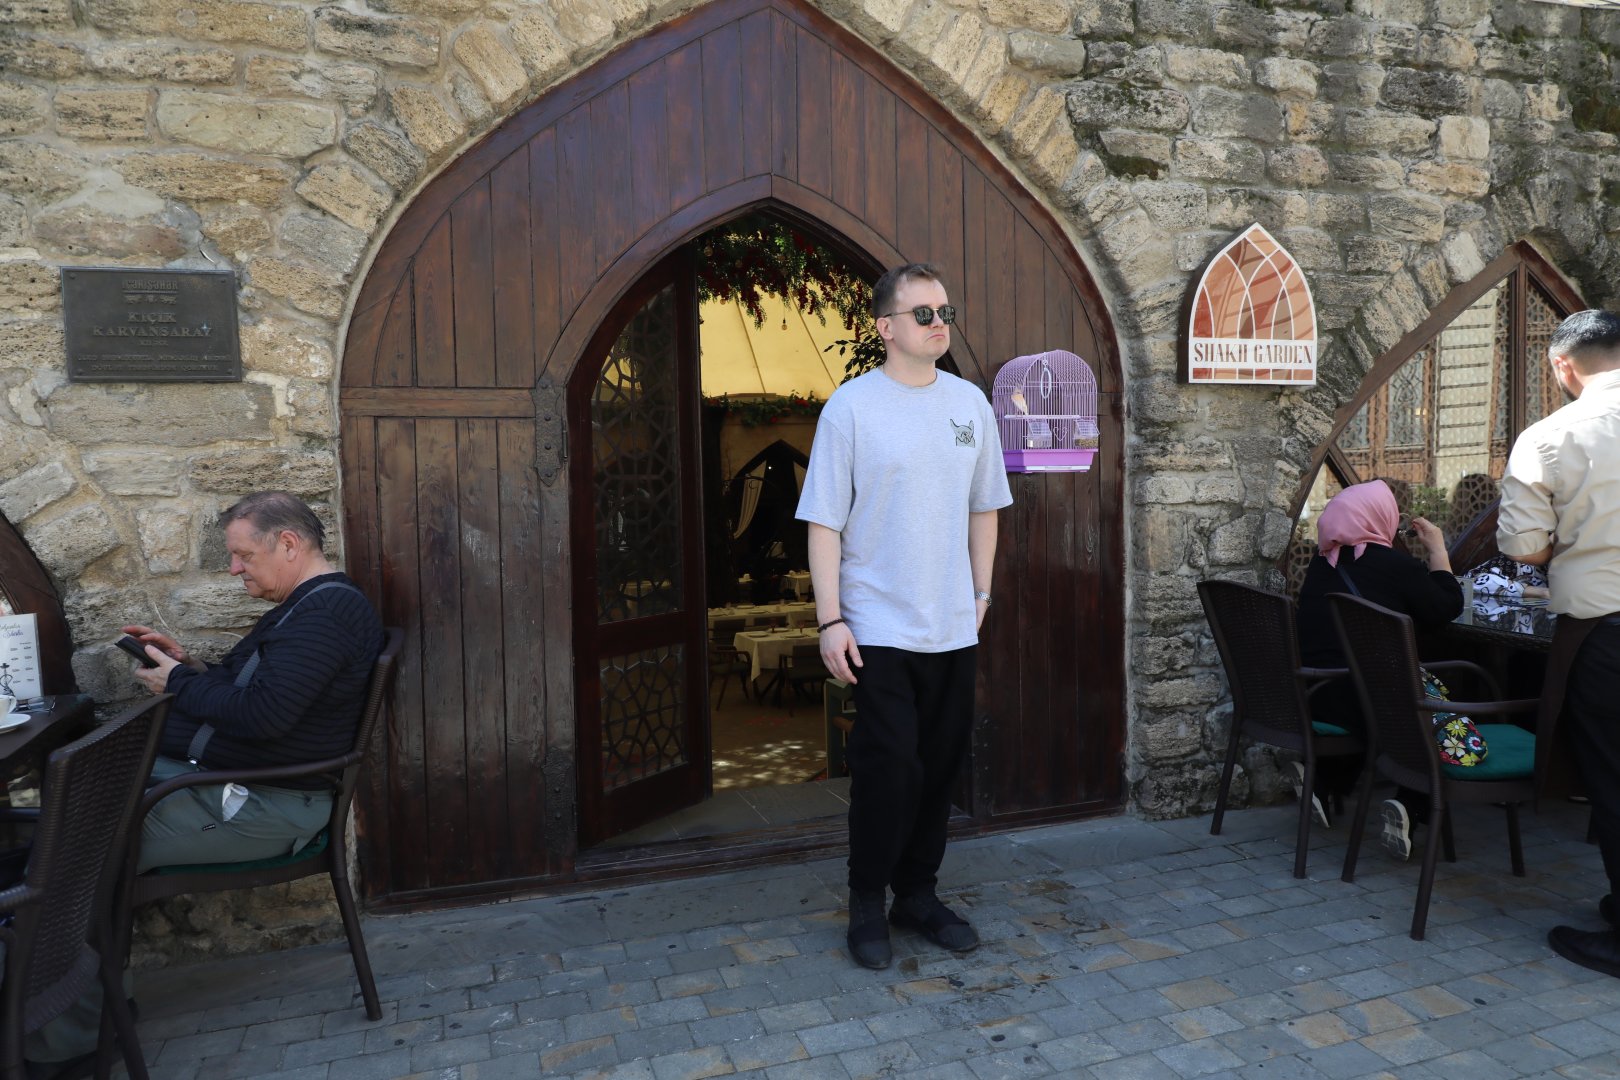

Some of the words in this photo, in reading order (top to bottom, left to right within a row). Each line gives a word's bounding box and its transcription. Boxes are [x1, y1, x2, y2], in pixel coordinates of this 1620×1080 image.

[92, 325, 212, 337] KARVANSARAY
[1193, 342, 1248, 363] SHAKH
[1253, 344, 1313, 364] GARDEN
